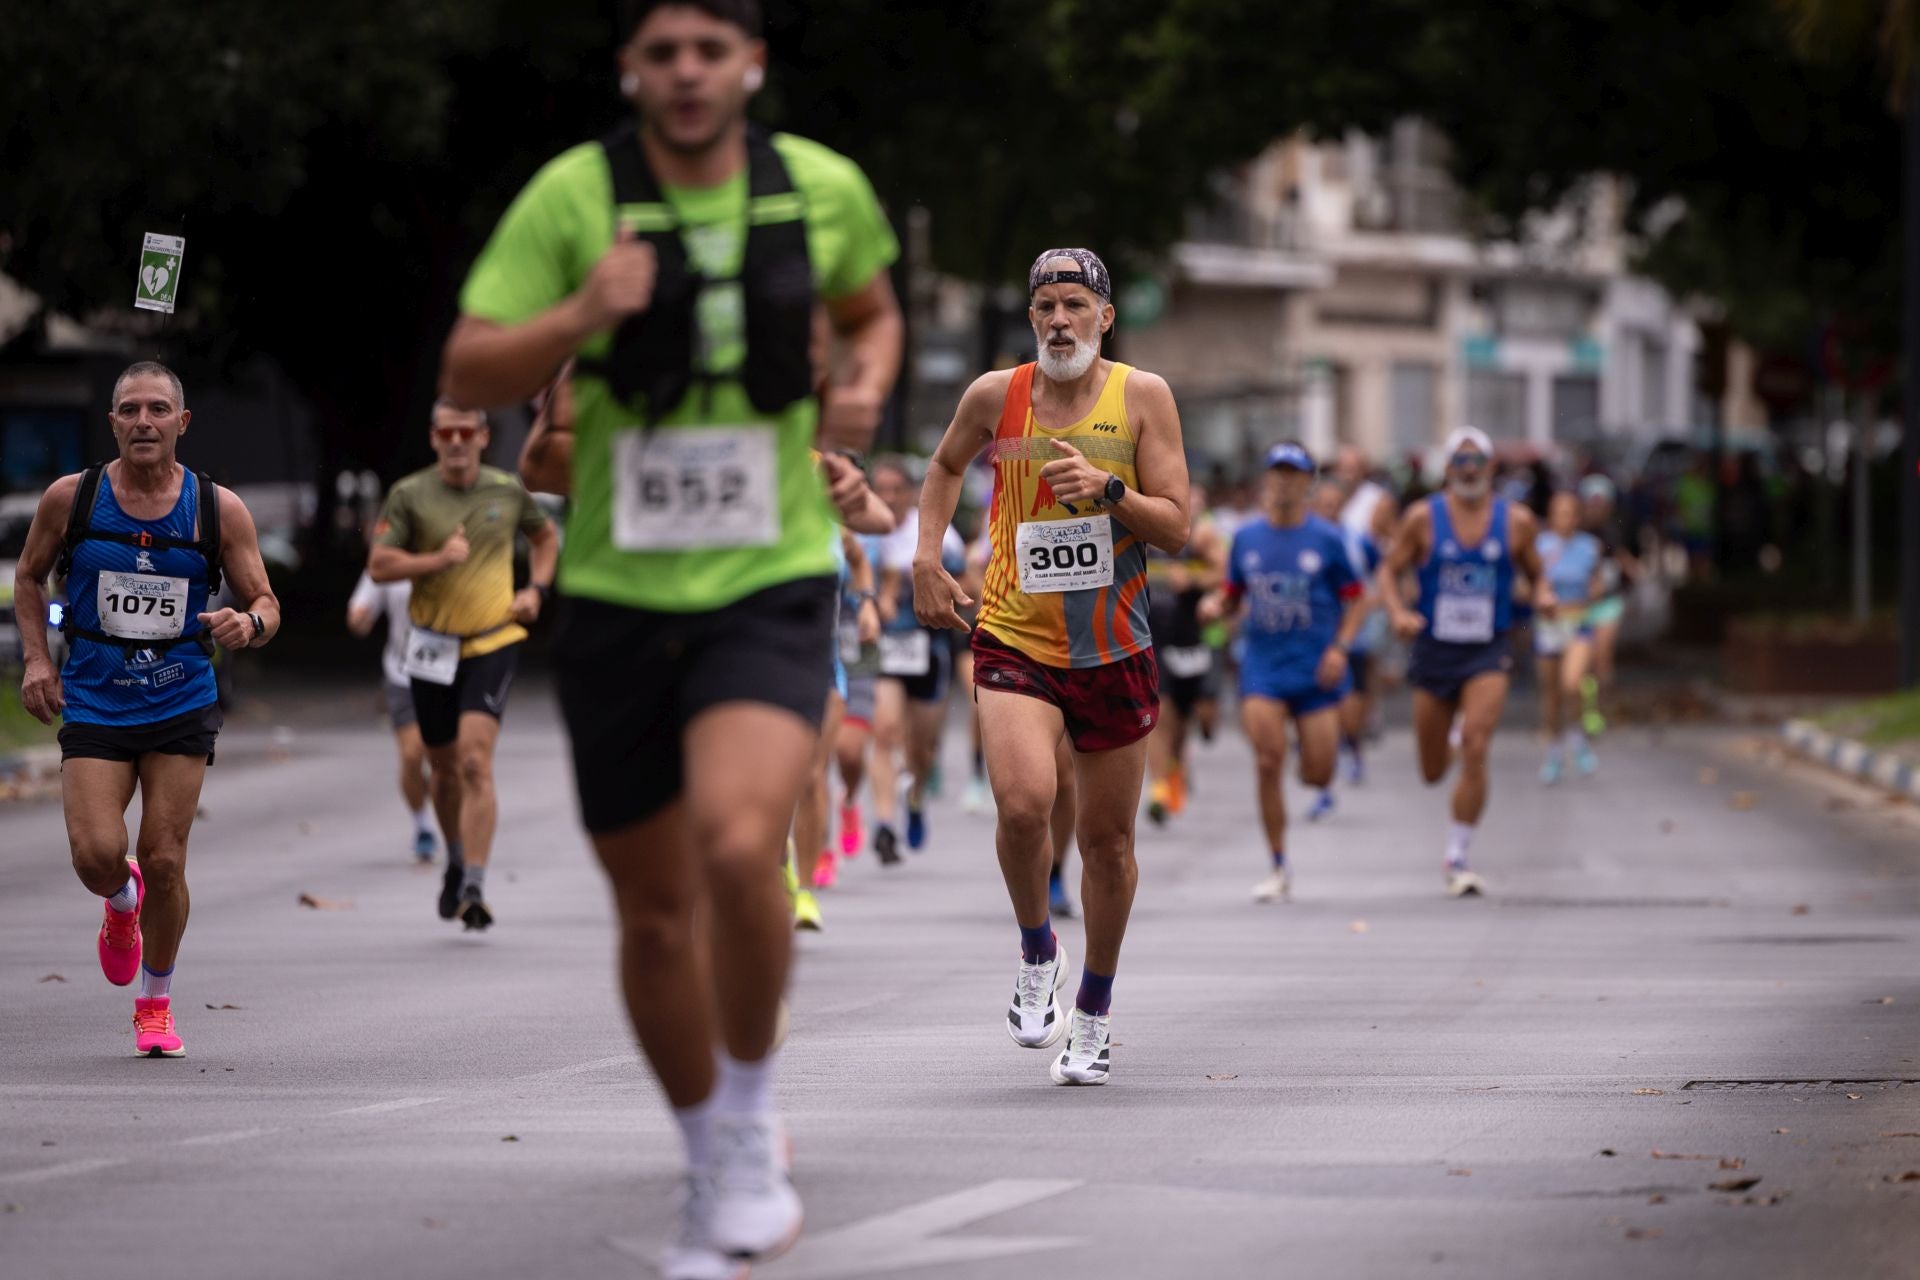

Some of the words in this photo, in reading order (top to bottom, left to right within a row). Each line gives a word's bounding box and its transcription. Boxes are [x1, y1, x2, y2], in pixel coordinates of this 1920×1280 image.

[160, 293, 172, 302] DEA
[1029, 542, 1098, 571] 300
[105, 593, 176, 617] 1075
